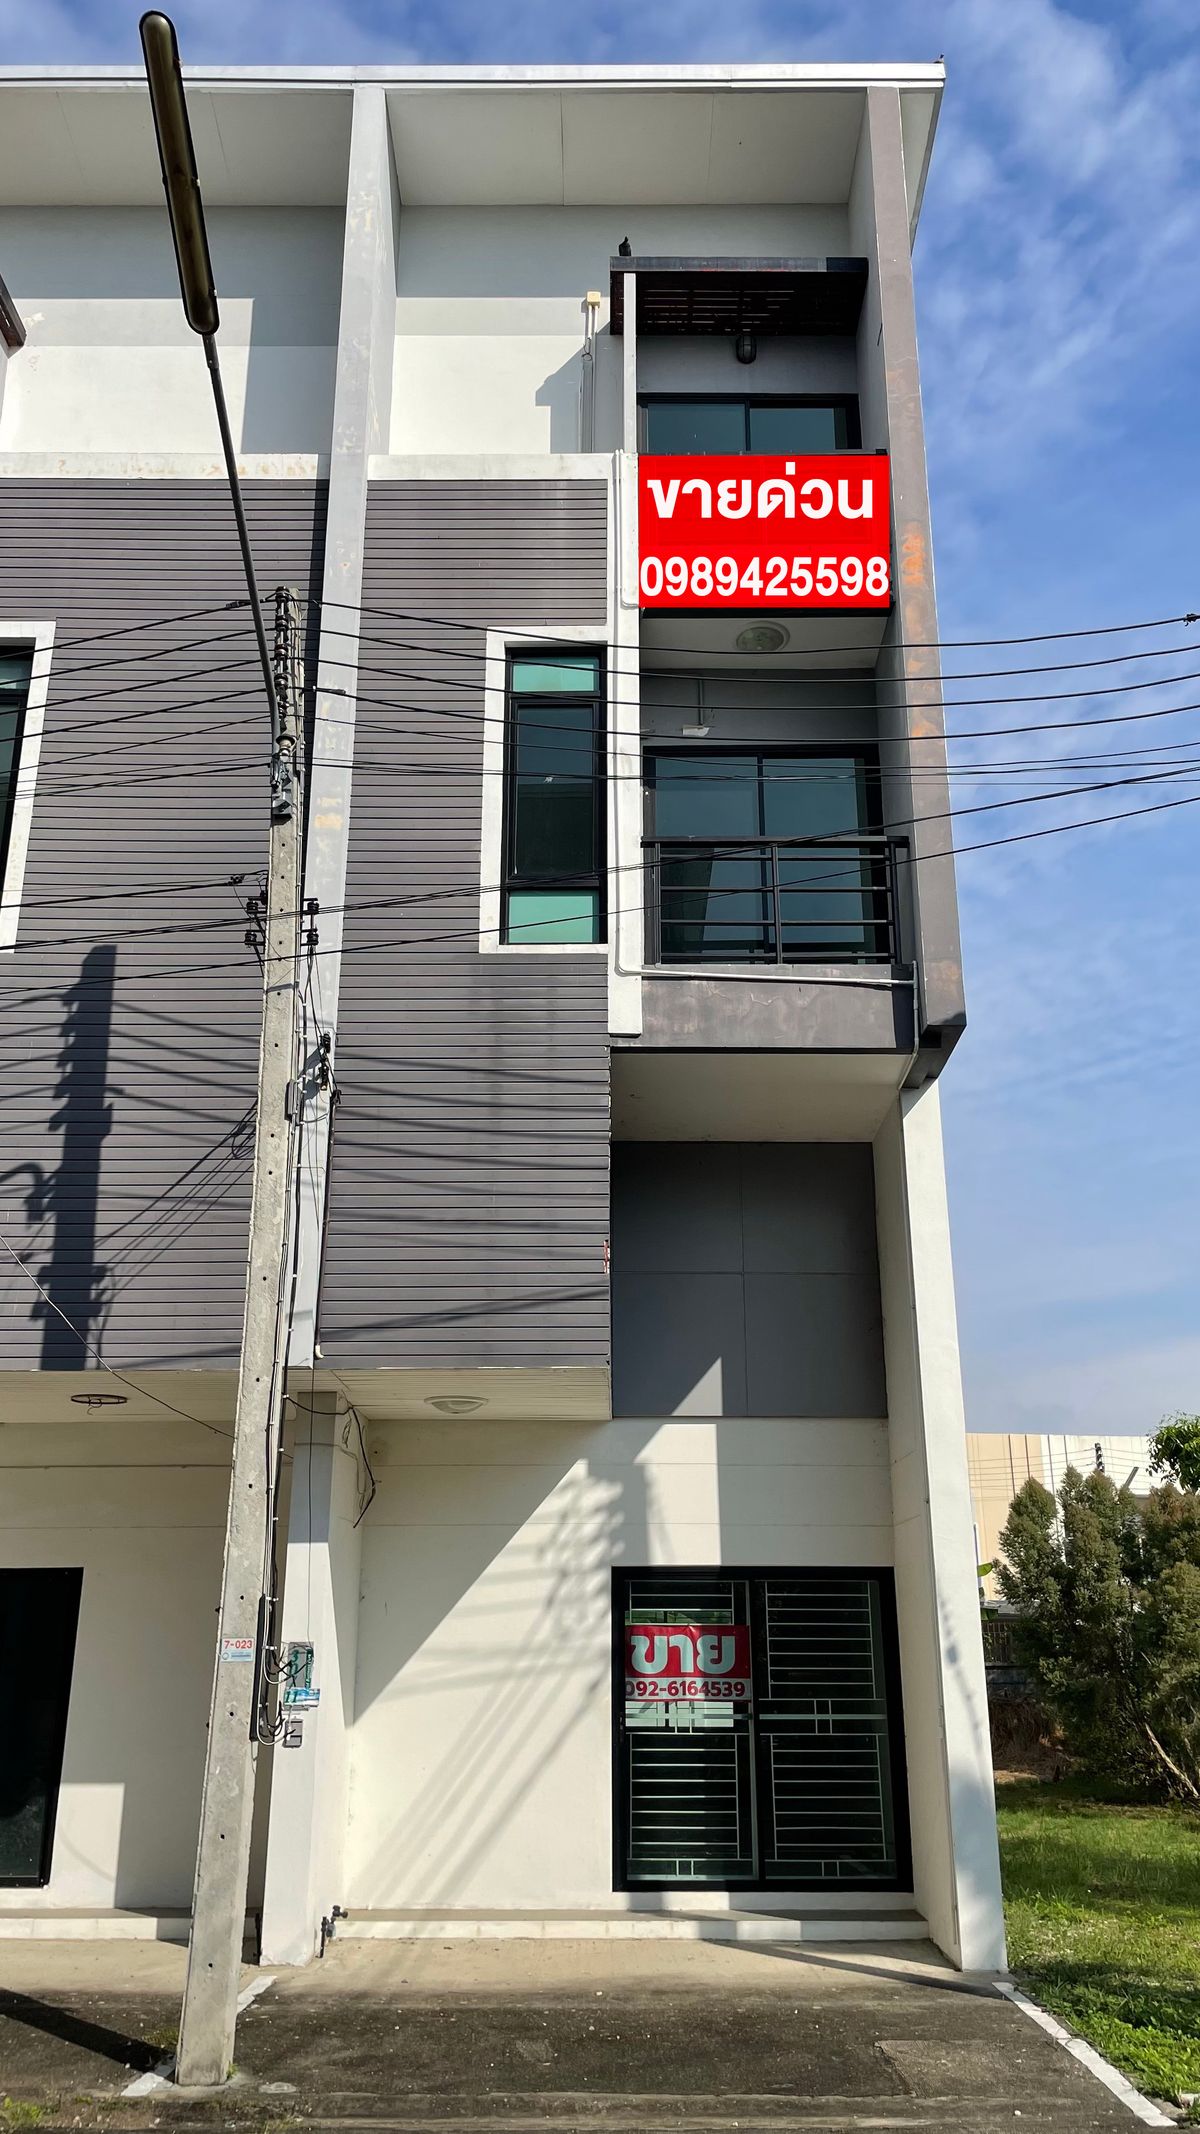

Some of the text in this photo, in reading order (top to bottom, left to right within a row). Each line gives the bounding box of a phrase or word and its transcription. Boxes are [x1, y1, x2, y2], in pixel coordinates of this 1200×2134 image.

[647, 462, 873, 519] ขายด่วน
[640, 556, 889, 597] 0989425598
[224, 1640, 252, 1649] 7-023
[630, 1634, 736, 1675] ขาย
[625, 1680, 746, 1697] 092-6164539
